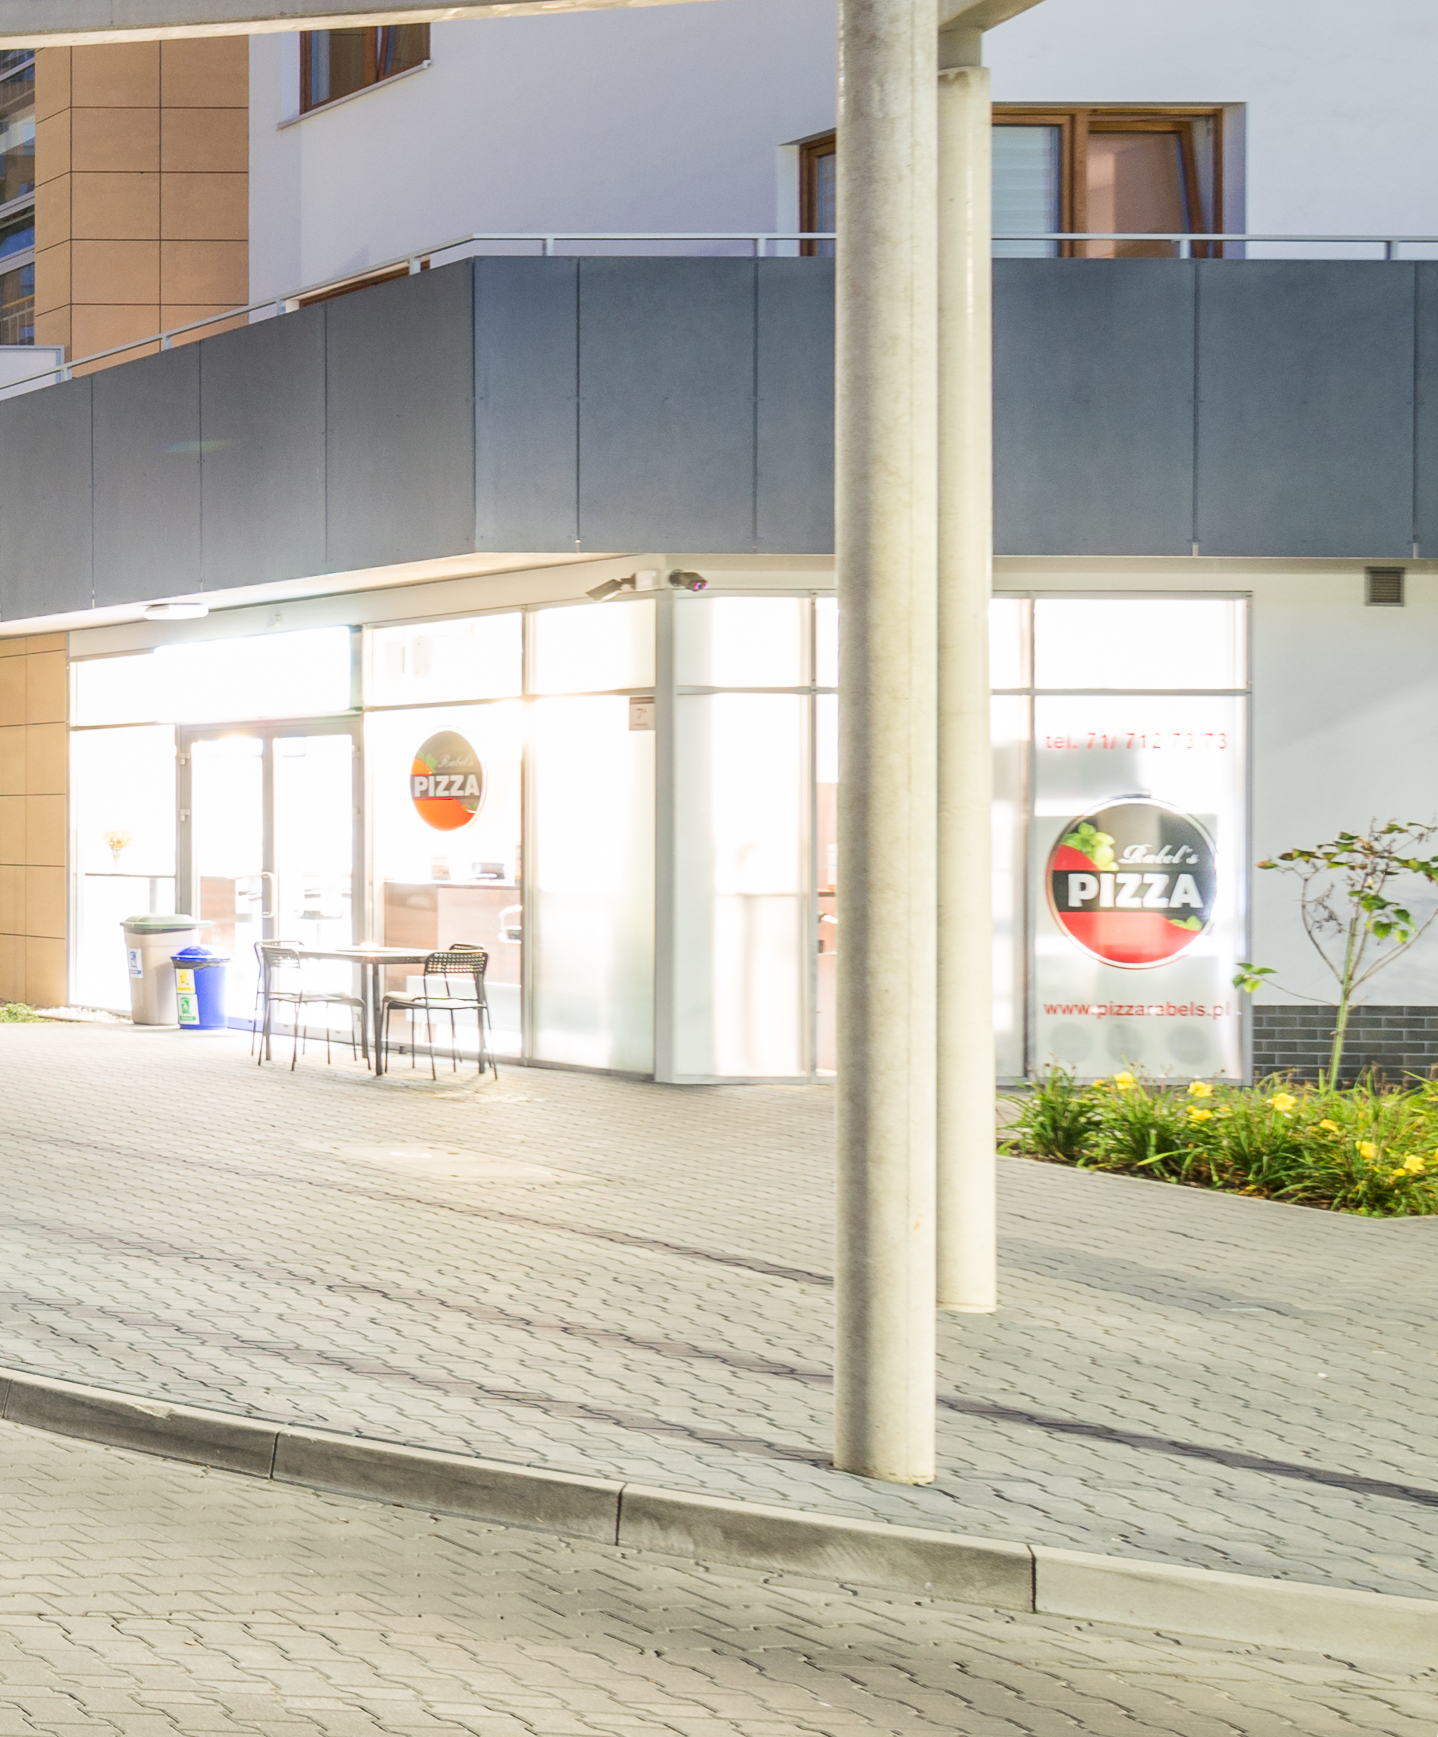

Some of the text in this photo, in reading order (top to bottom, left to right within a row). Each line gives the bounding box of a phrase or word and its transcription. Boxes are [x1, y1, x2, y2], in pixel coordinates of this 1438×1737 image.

[1045, 732, 1079, 750] tel.
[414, 774, 480, 797] PIZZA
[1068, 872, 1204, 908] PIZZA
